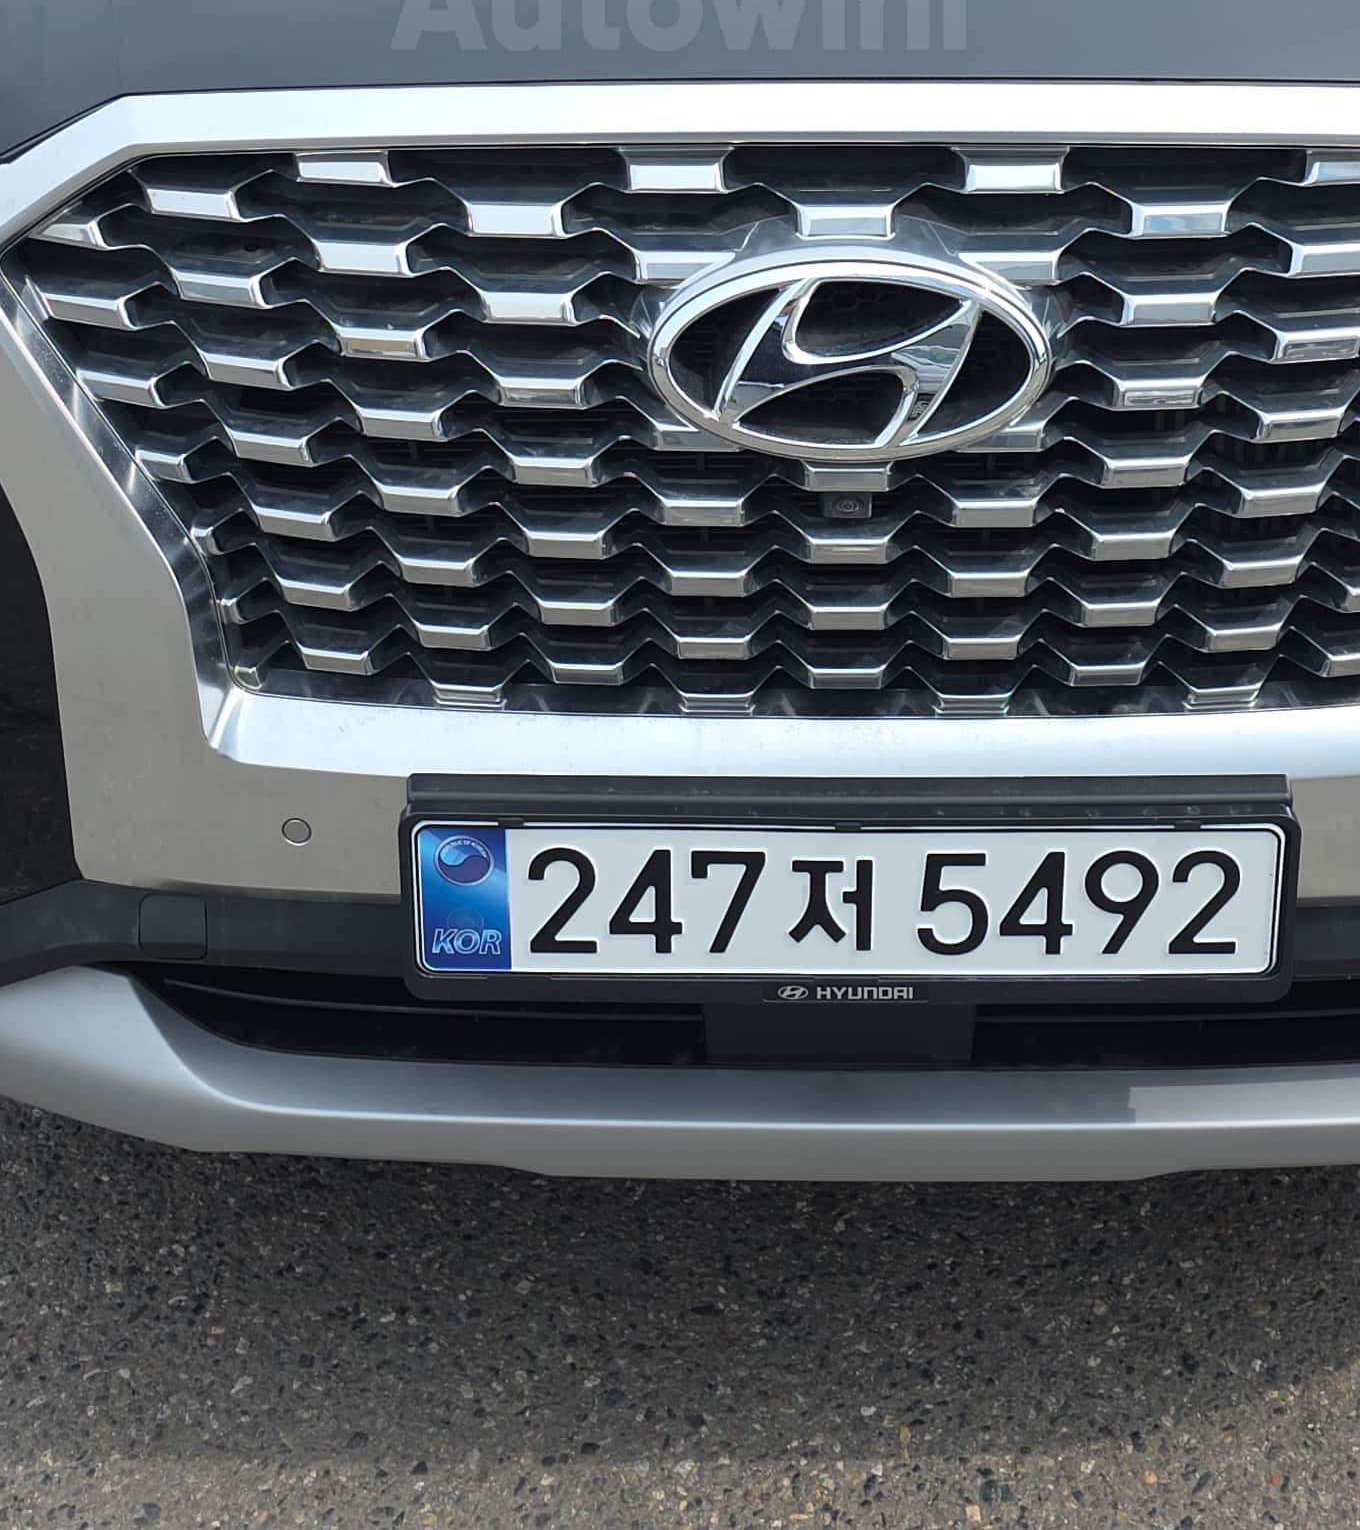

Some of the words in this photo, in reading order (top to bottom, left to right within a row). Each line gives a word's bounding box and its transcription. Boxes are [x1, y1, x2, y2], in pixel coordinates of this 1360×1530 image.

[527, 847, 873, 954] 247저
[916, 850, 1241, 956] 5492
[431, 928, 502, 955] KOR
[816, 986, 914, 1000] HYUNDAI
